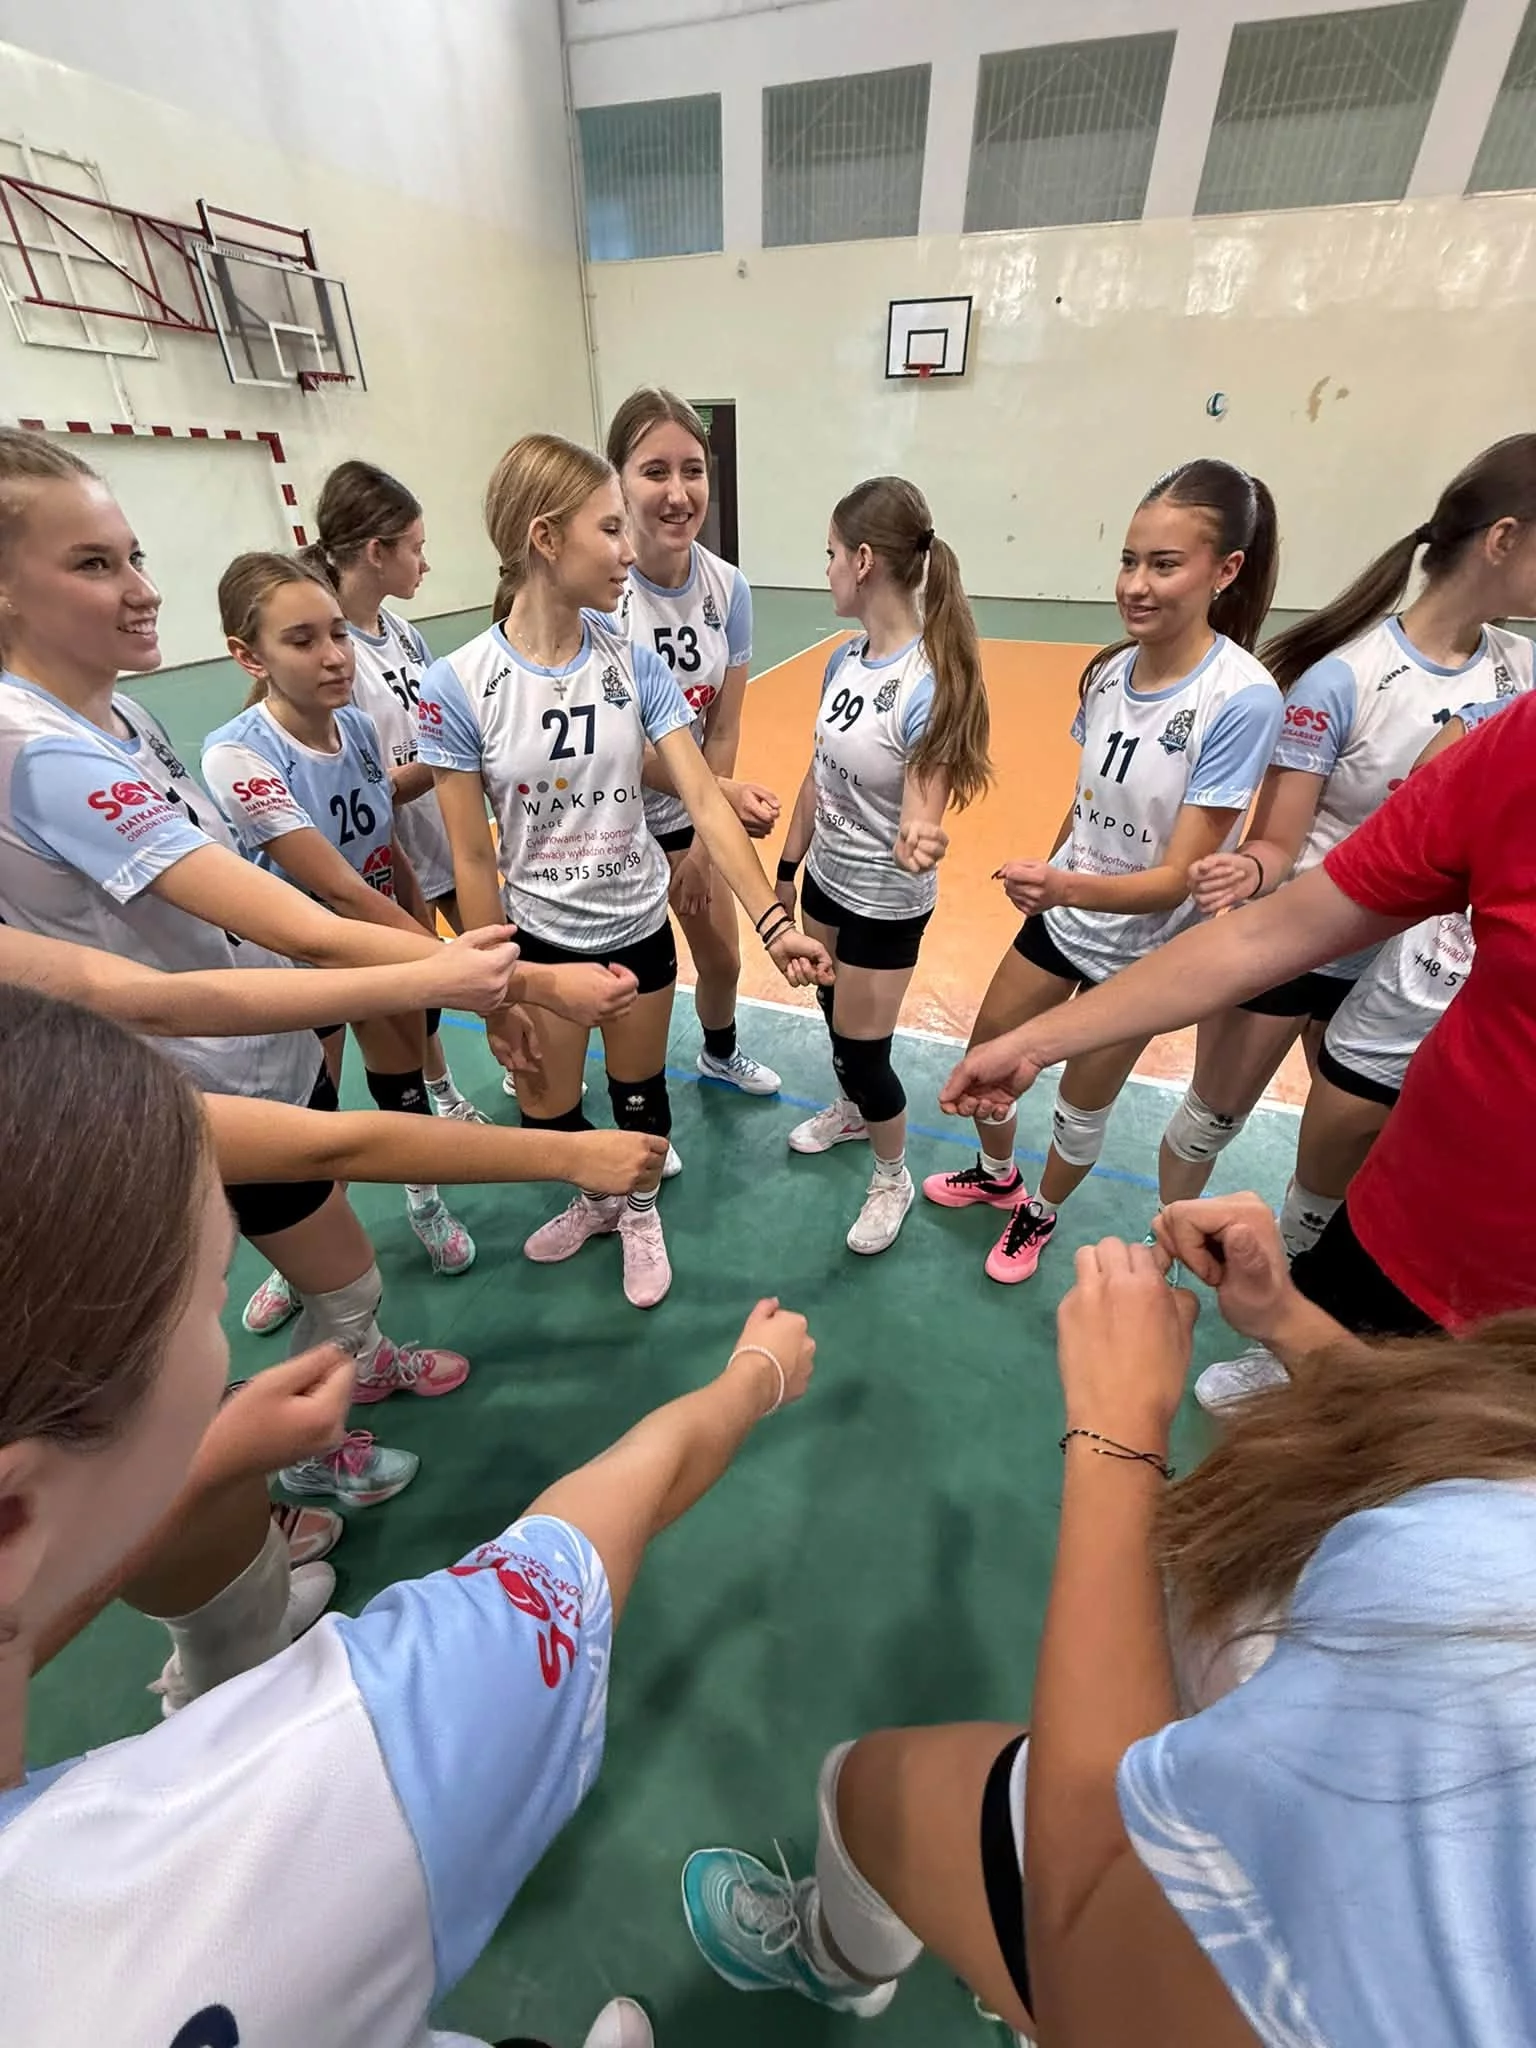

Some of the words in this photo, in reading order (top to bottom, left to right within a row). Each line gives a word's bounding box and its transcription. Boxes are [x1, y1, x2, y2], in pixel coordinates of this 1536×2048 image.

[653, 625, 702, 673] 53
[825, 687, 865, 732] 99
[1283, 704, 1331, 732] SOS
[541, 703, 596, 761] 27
[814, 747, 863, 787] AKPOL
[1099, 730, 1141, 784] 11
[232, 777, 287, 803] SOS
[522, 784, 638, 817] WAKPOL
[329, 787, 376, 847] 26
[526, 818, 563, 833] TRADE
[1074, 803, 1153, 843] AKPOL
[532, 866, 560, 882] +48
[565, 865, 590, 881] 515
[597, 861, 622, 878] 550
[1414, 952, 1442, 978] +48
